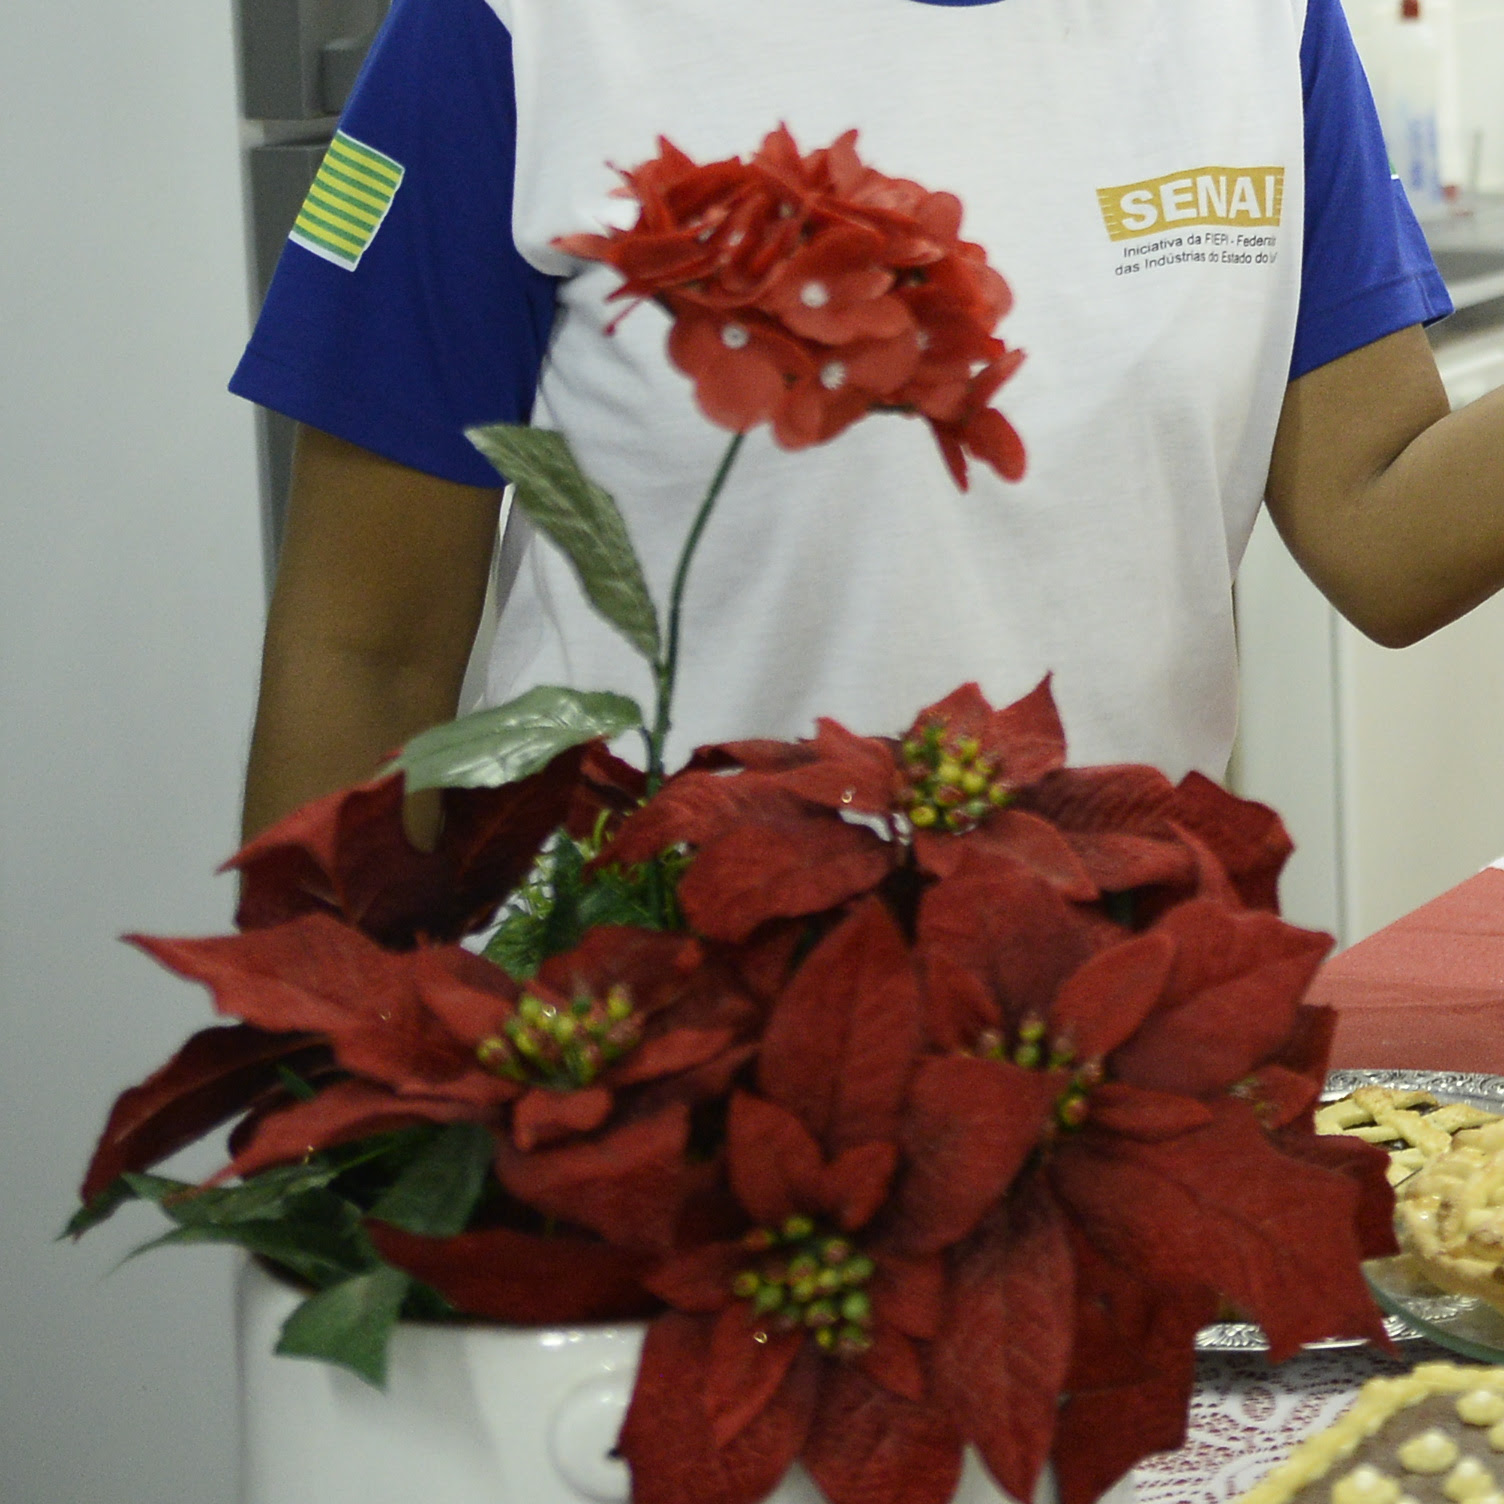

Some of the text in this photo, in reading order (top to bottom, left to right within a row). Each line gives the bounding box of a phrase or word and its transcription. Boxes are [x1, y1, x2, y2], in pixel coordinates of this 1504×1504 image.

[1119, 175, 1275, 231] SENAI
[1124, 237, 1183, 258] Iniciativa
[1187, 234, 1202, 245] da
[1115, 262, 1140, 276] das
[1145, 251, 1206, 269] Indústrias
[1209, 251, 1219, 263] do
[1222, 251, 1251, 264] Estado
[1255, 252, 1268, 264] do
